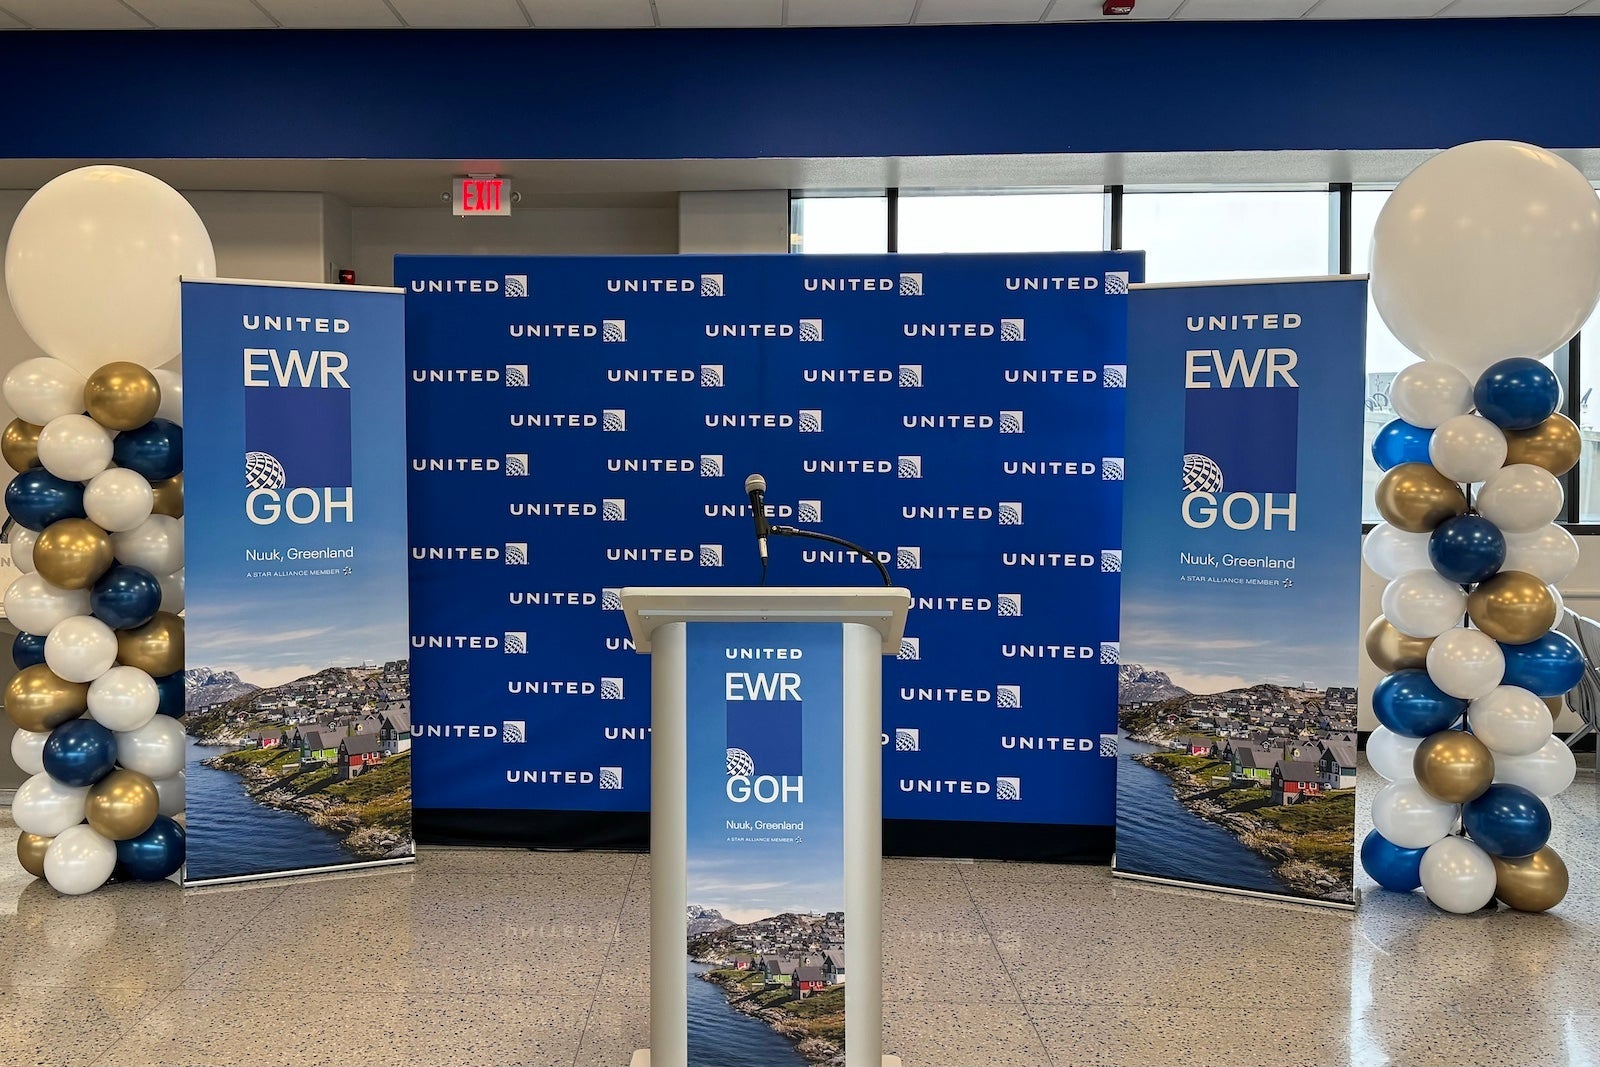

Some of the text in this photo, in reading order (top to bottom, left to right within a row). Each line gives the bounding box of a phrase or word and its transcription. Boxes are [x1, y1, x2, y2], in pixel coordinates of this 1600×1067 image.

[463, 180, 503, 211] EXIT
[412, 280, 498, 292] UNITED
[608, 280, 694, 292] UNITED
[805, 279, 893, 291] UNITED
[1006, 278, 1098, 290] UNITED
[243, 315, 350, 333] UNITED
[1187, 314, 1302, 331] UNITED
[510, 325, 596, 337] UNITED
[706, 325, 793, 336] UNITED
[904, 324, 994, 336] UNITED
[243, 348, 351, 388] EWR
[1185, 348, 1300, 389] EWR
[413, 370, 499, 382] UNITED
[608, 370, 694, 381] UNITED
[804, 370, 892, 382] UNITED
[1005, 370, 1096, 382] UNITED
[511, 415, 597, 426] UNITED
[706, 415, 793, 427] UNITED
[904, 416, 993, 427] UNITED
[413, 459, 499, 470] UNITED
[608, 460, 694, 471] UNITED
[804, 461, 891, 472] UNITED
[1004, 462, 1095, 474] UNITED
[245, 487, 354, 525] GOH
[510, 504, 596, 515] UNITED
[1182, 491, 1297, 531] GOH
[903, 507, 992, 519] UNITED
[246, 546, 354, 562] Nuuk, Greenland
[413, 548, 499, 559] UNITED
[607, 549, 693, 561] UNITED
[1003, 553, 1094, 566] UNITED
[1180, 552, 1295, 569] Nuuk, Greenland
[310, 568, 340, 576] MEMBER
[1207, 576, 1243, 584] ALLIANCE
[1245, 578, 1279, 586] MEMBER
[510, 593, 596, 604] UNITED
[412, 636, 498, 648] UNITED
[726, 648, 803, 660] UNITED
[1003, 645, 1093, 658] UNITED
[509, 682, 595, 694] UNITED
[726, 672, 803, 701] EWR
[901, 688, 990, 702] UNITED
[411, 725, 497, 737] UNITED
[1002, 737, 1093, 750] UNITED
[507, 771, 593, 783] UNITED
[726, 775, 804, 803] GOH
[900, 780, 990, 793] UNITED
[726, 820, 804, 831] Nuuk, Greenland
